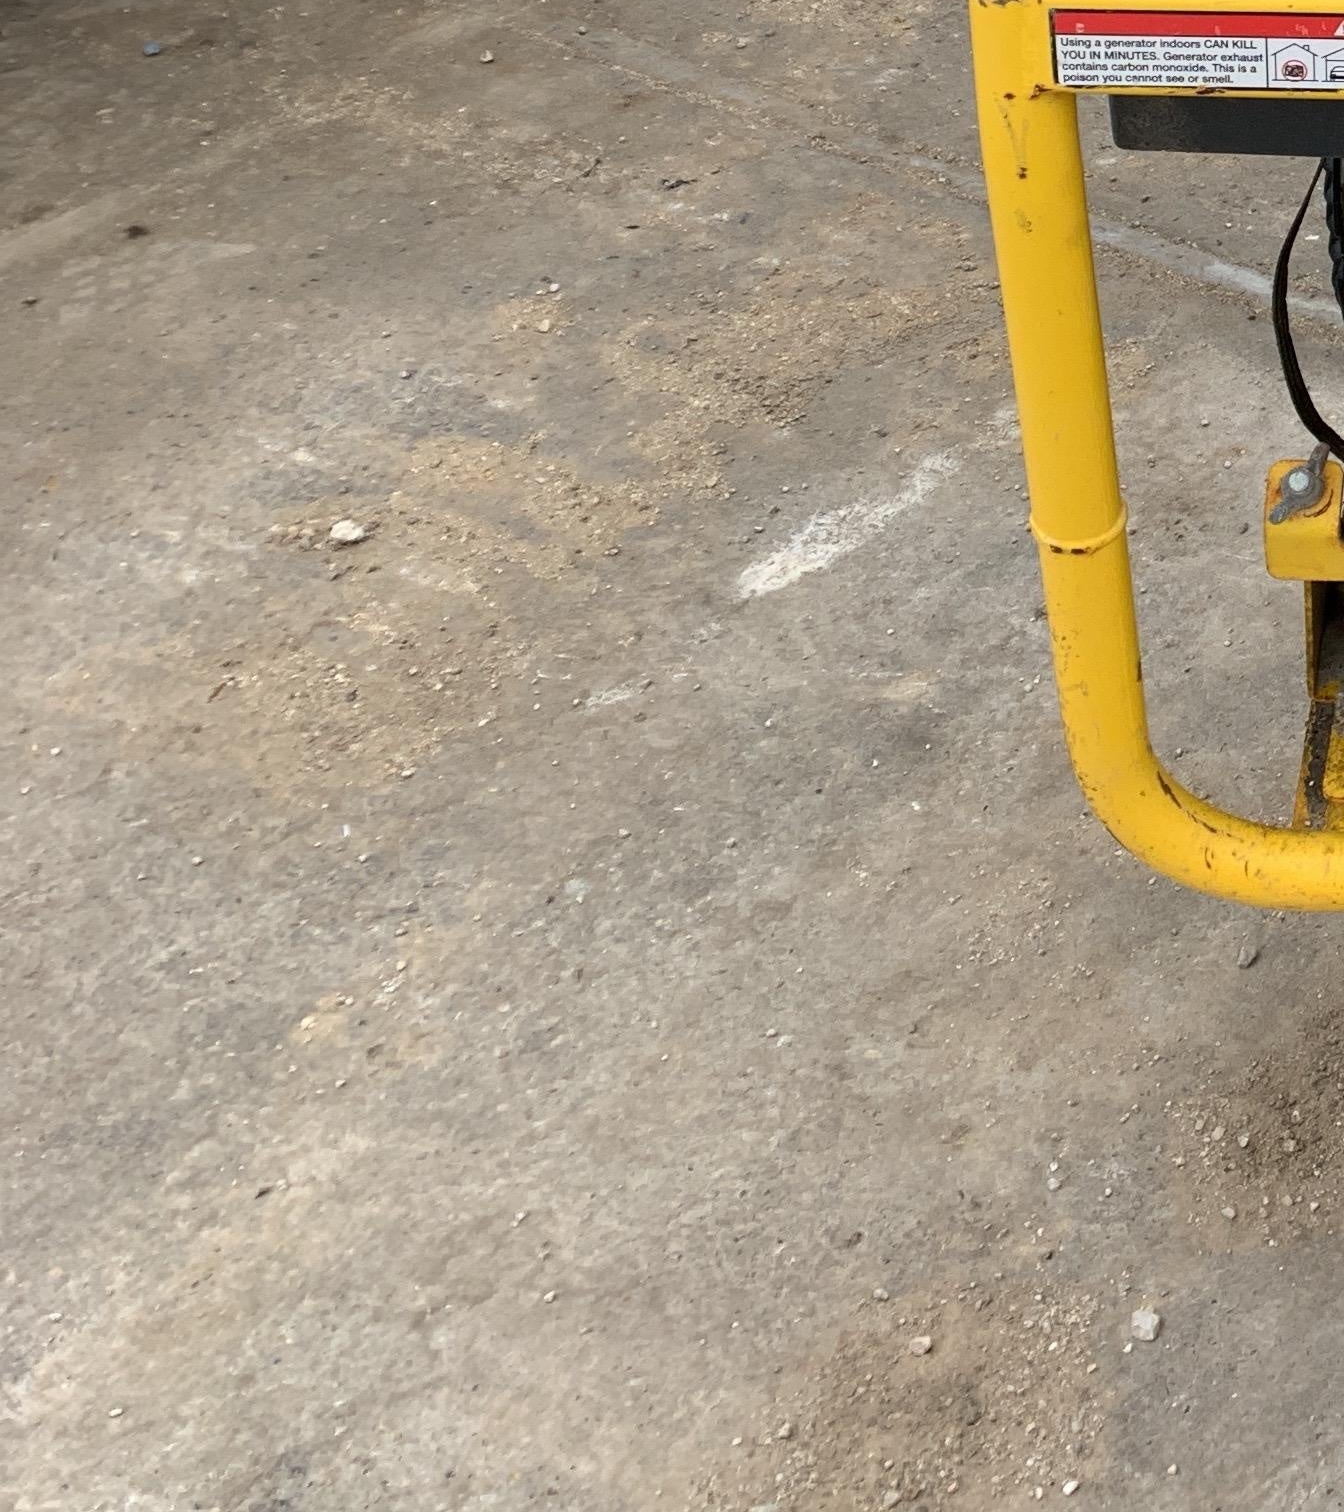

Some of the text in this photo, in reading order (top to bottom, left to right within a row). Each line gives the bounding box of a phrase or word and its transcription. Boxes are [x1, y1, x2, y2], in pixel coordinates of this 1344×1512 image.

[1060, 37, 1257, 49] Using a generator indoors CAN KILL
[1061, 50, 1263, 62] YOU IN MINUTES. Generator exhaust
[1062, 62, 1257, 73] contains carbon monoxide. This is a
[1063, 73, 1099, 83] poison
[1102, 75, 1122, 84] you
[1125, 74, 1162, 83] cannot
[1166, 75, 1185, 83] see
[1187, 75, 1199, 83] or
